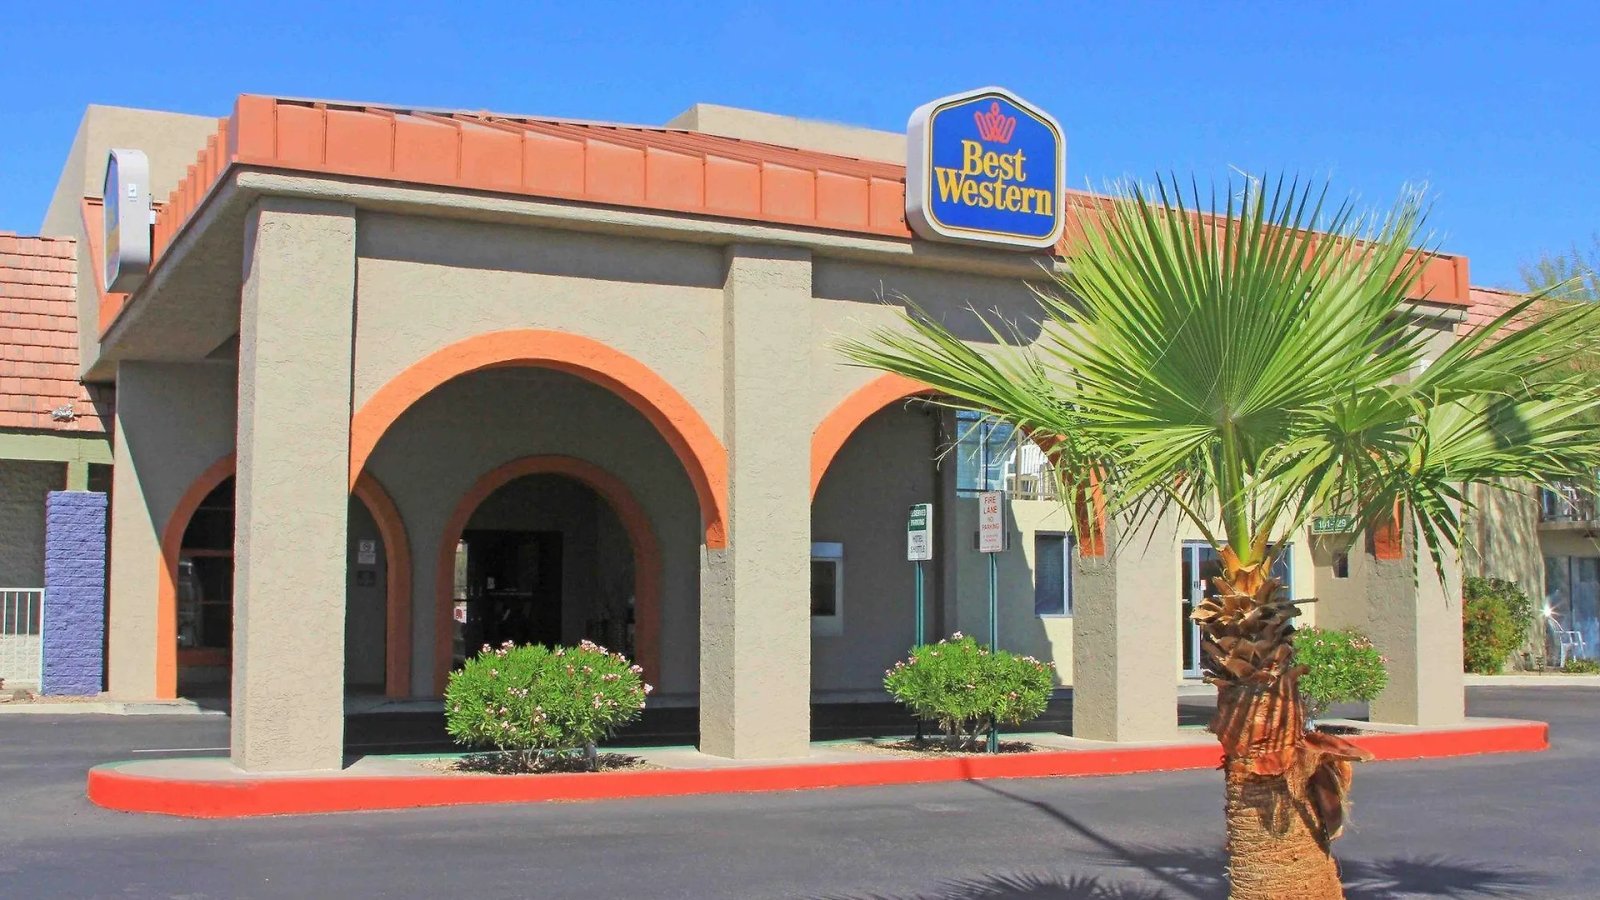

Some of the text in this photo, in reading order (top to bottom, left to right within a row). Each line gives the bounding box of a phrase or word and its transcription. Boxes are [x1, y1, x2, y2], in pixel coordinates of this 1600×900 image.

[961, 139, 1026, 182] Best
[934, 166, 1053, 216] Western
[984, 496, 996, 505] FIRE
[983, 505, 998, 514] LANE
[981, 523, 1000, 531] PARKING
